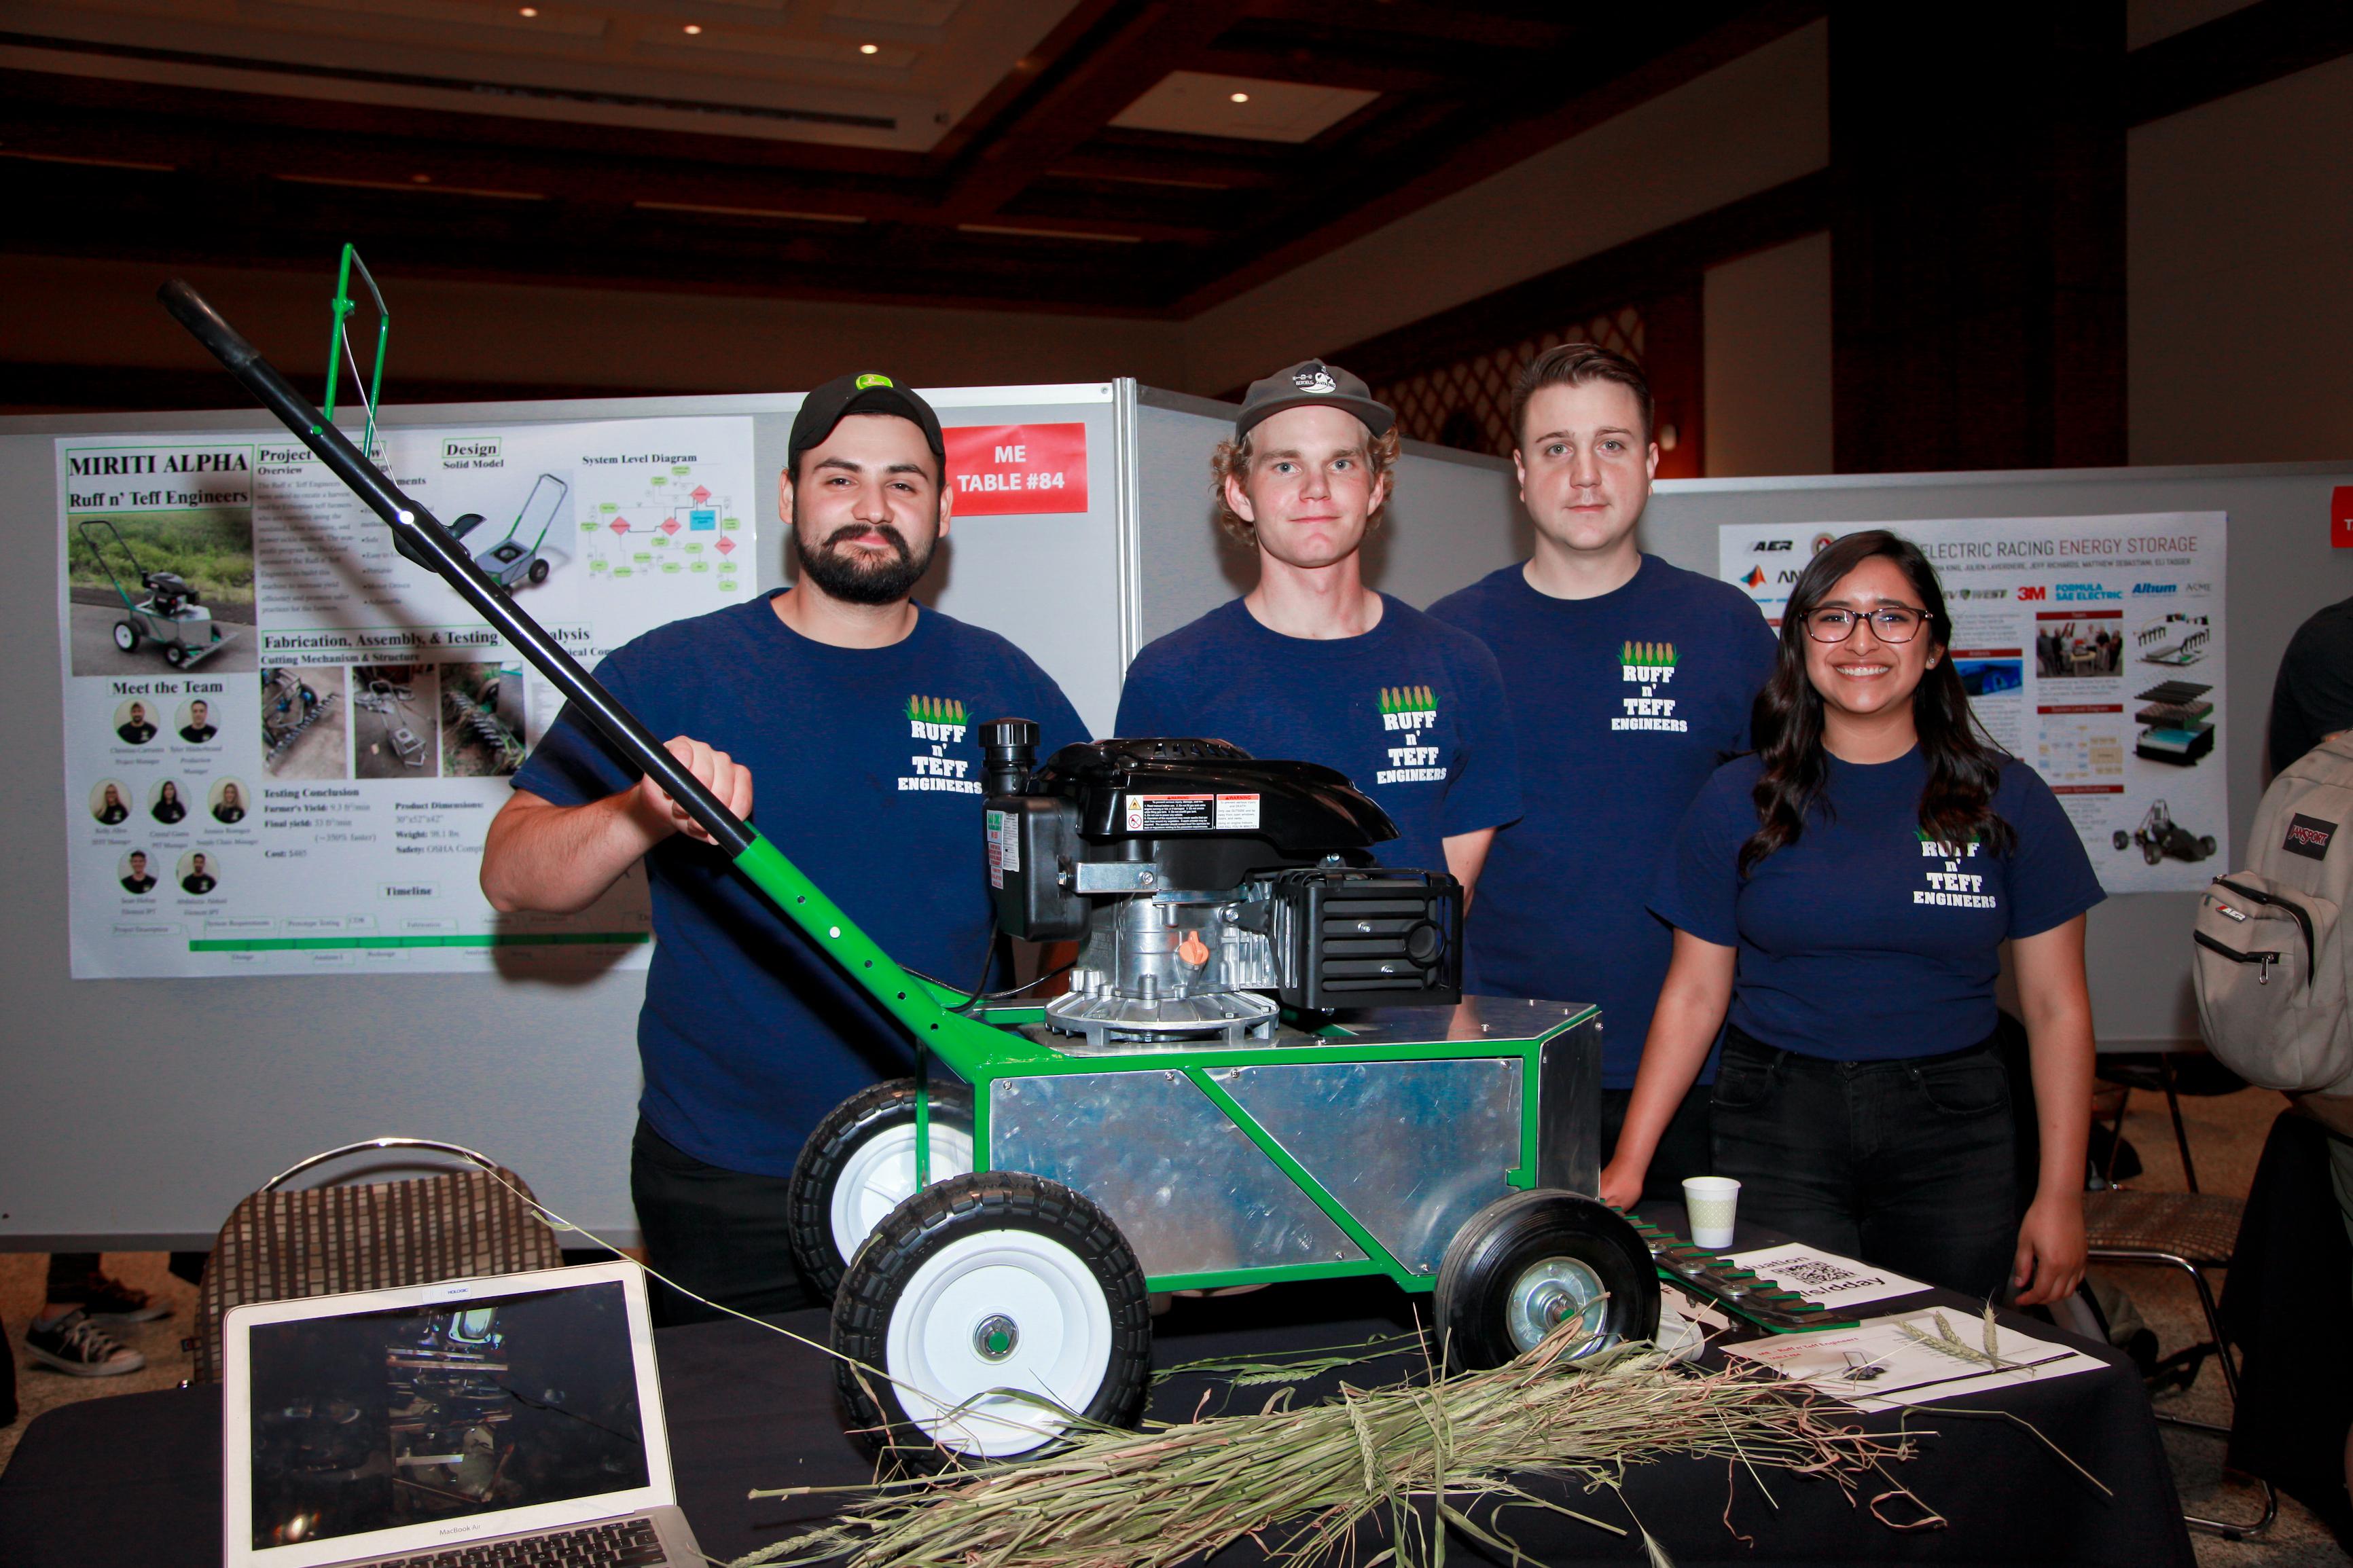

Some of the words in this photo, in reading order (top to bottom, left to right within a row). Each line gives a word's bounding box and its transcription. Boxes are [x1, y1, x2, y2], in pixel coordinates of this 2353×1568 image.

[261, 449, 312, 462] Project
[447, 443, 497, 458] Design
[994, 445, 1026, 463] ME
[69, 455, 156, 477] MIRITI
[164, 452, 249, 474] ALPHA
[443, 460, 469, 469] Solid
[473, 458, 504, 469] Model
[583, 455, 617, 466] System
[622, 454, 649, 463] Level
[652, 454, 697, 464] Diagram
[258, 466, 302, 475] Overview
[956, 473, 1022, 492] TABLE
[1026, 472, 1065, 489] #84
[69, 491, 103, 507] Ruff
[130, 490, 161, 506] Teff
[166, 488, 248, 505] Engineers
[1754, 541, 1793, 551] AER
[1997, 540, 2054, 557] RACING
[2060, 539, 2122, 555] ENERGY
[2127, 536, 2198, 553] STORAGE
[2017, 587, 2045, 600] 3M
[2055, 584, 2102, 592] FORMULA
[2132, 583, 2178, 594] Altium
[2055, 592, 2074, 600] SAE
[2076, 591, 2122, 600] ELECTRIC
[265, 636, 353, 649] Fabrication,
[357, 634, 426, 649] Assembly,
[430, 633, 440, 644] &
[446, 632, 498, 646] Testing
[549, 627, 590, 642] alysis
[261, 656, 299, 665] Cutting
[302, 655, 359, 663] Mechanism
[361, 653, 370, 661] &
[372, 653, 420, 661] Structure
[1623, 666, 1675, 683] RUFF
[112, 682, 150, 694] Meet
[155, 682, 179, 693] the
[183, 680, 224, 693] Team
[1623, 698, 1676, 716] TEFF
[1383, 710, 1437, 731] RUFF
[1611, 718, 1688, 732] ENGINEERS
[910, 720, 966, 743] RUFF
[1388, 747, 1439, 767] TEFF
[912, 756, 968, 778] TEFF
[1376, 767, 1447, 784] ENGINEERS
[264, 789, 300, 799] Testing
[302, 788, 359, 797] Conclusion
[898, 778, 983, 795] ENGINEERS
[431, 801, 484, 809] Dimensions:
[289, 819, 312, 828] yield:
[395, 831, 428, 839] Weight:
[2288, 824, 2329, 845] JANSPORT
[396, 846, 425, 855] Safety:
[427, 845, 454, 853] OSHA
[1926, 872, 1983, 893] TEFF
[386, 887, 432, 896] Timeline
[1913, 891, 1996, 909] ENGINEERS
[2224, 907, 2246, 922] AER
[1800, 1277, 1886, 1297] ls/dday
[1820, 1338, 1858, 1347] Engineers
[439, 1525, 471, 1535] MacBook
